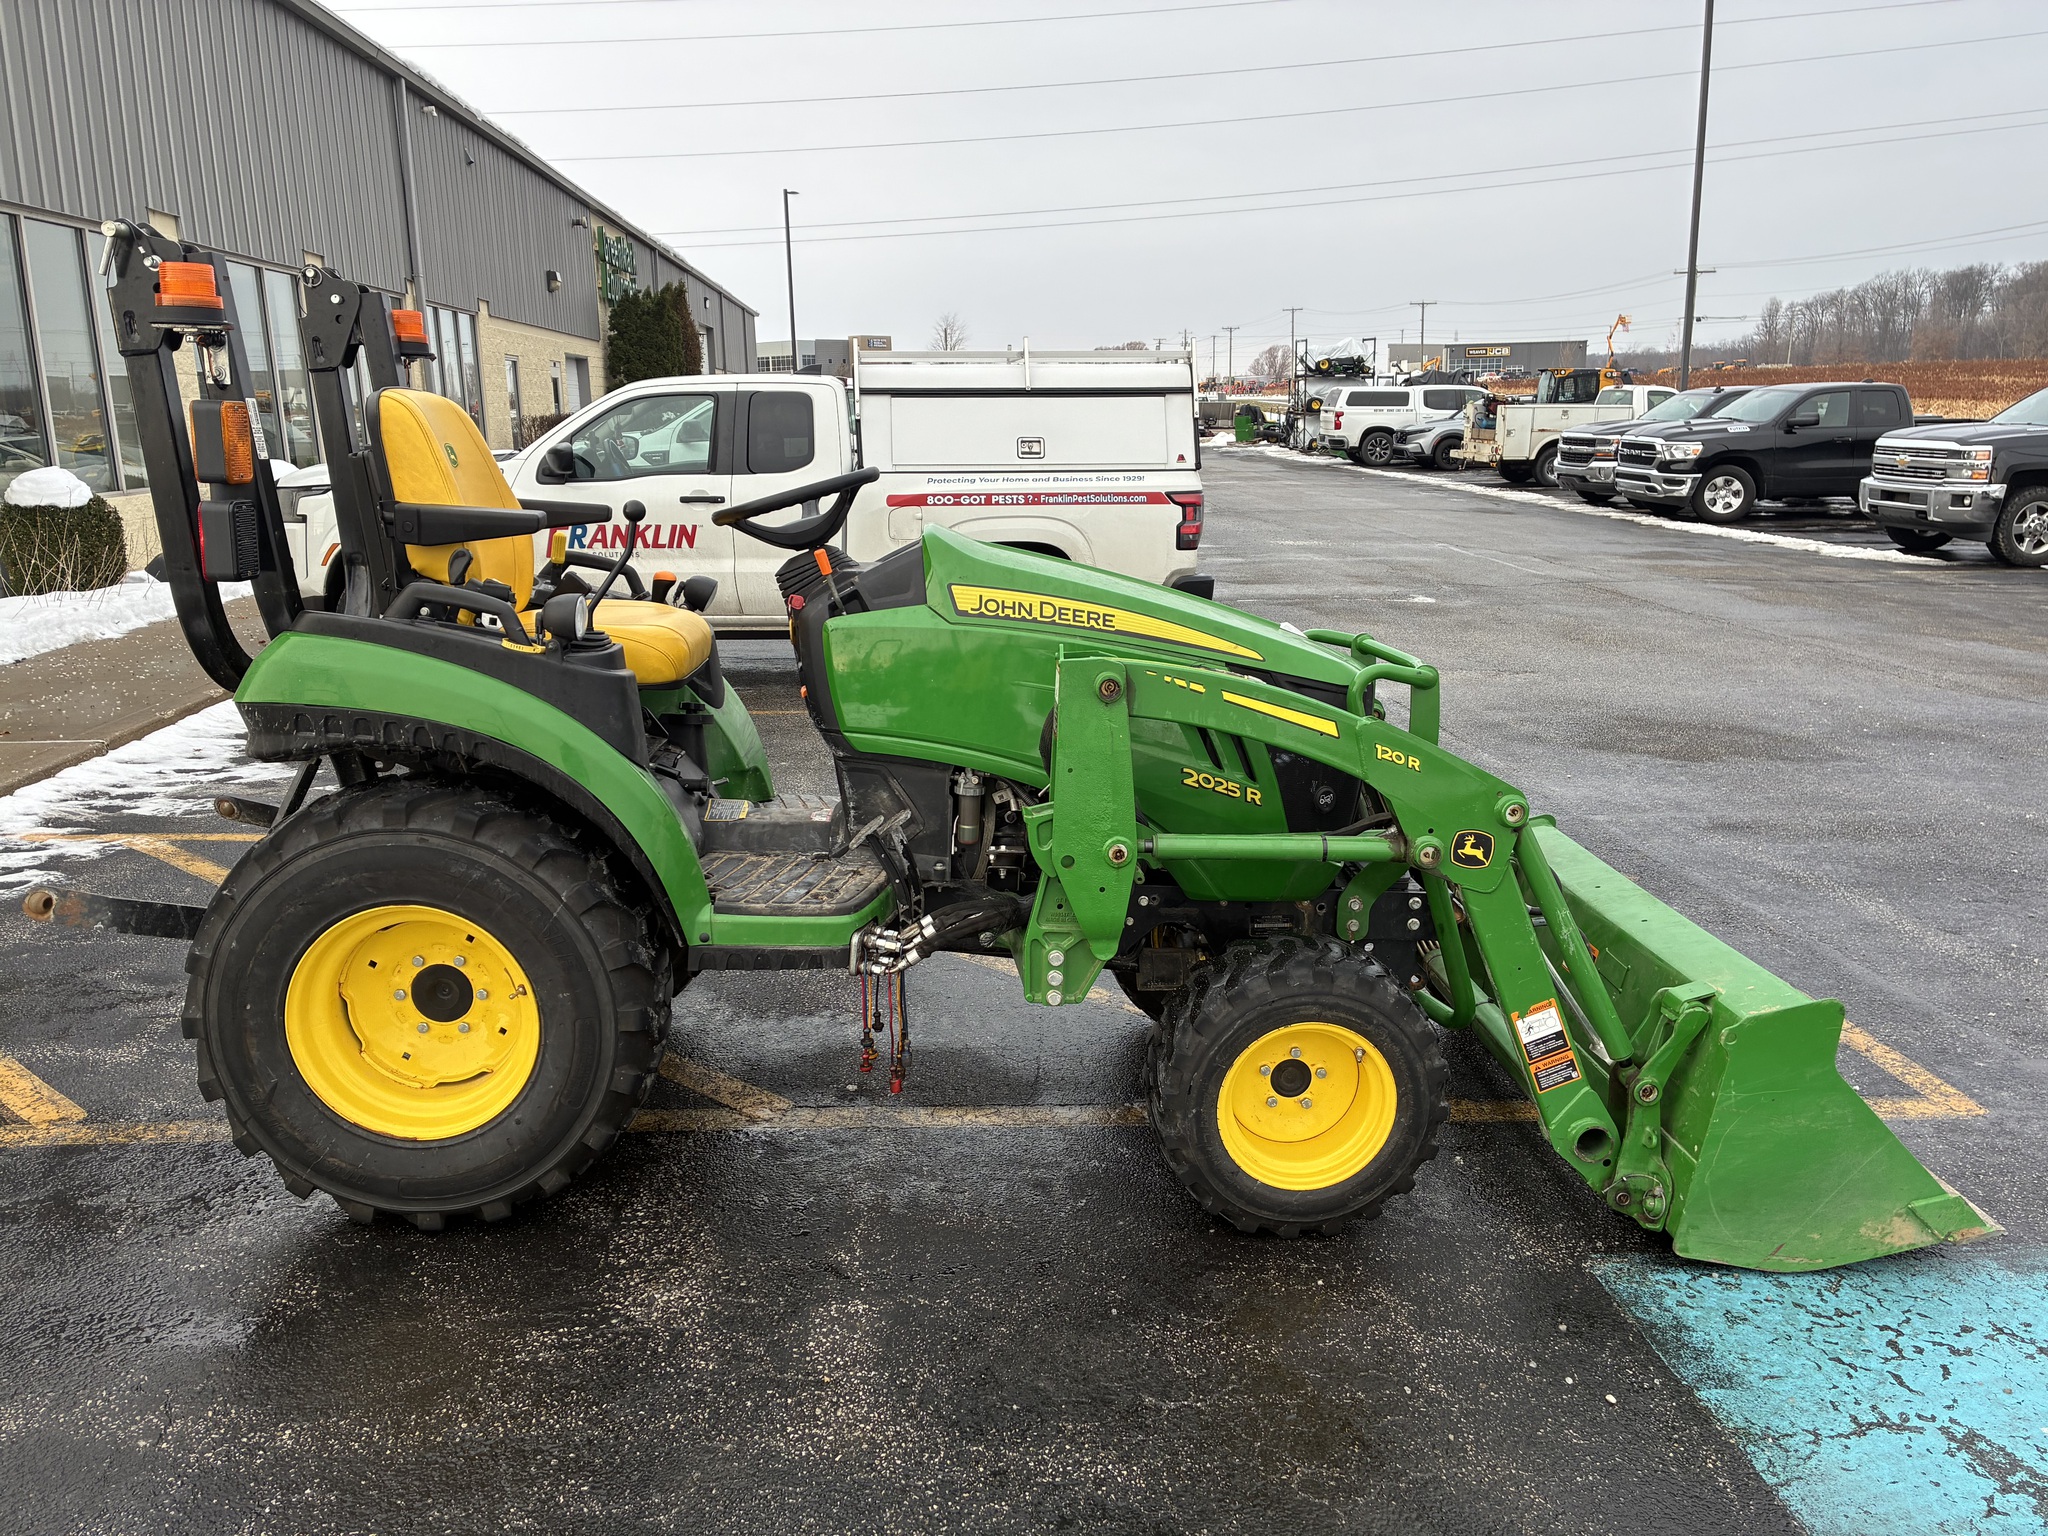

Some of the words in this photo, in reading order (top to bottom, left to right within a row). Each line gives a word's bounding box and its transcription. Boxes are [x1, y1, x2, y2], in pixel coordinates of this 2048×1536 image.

[926, 495, 986, 504] 800-GOT
[991, 495, 1025, 504] PESTS
[1040, 493, 1147, 503] FranklinPestSolutions.com
[970, 594, 1033, 618] JOHN
[1039, 600, 1116, 629] DEERE
[1375, 743, 1406, 765] 120
[1407, 755, 1421, 773] R
[1182, 767, 1242, 798] 2025
[1246, 786, 1262, 807] R
[1541, 1054, 1570, 1067] WARNING
